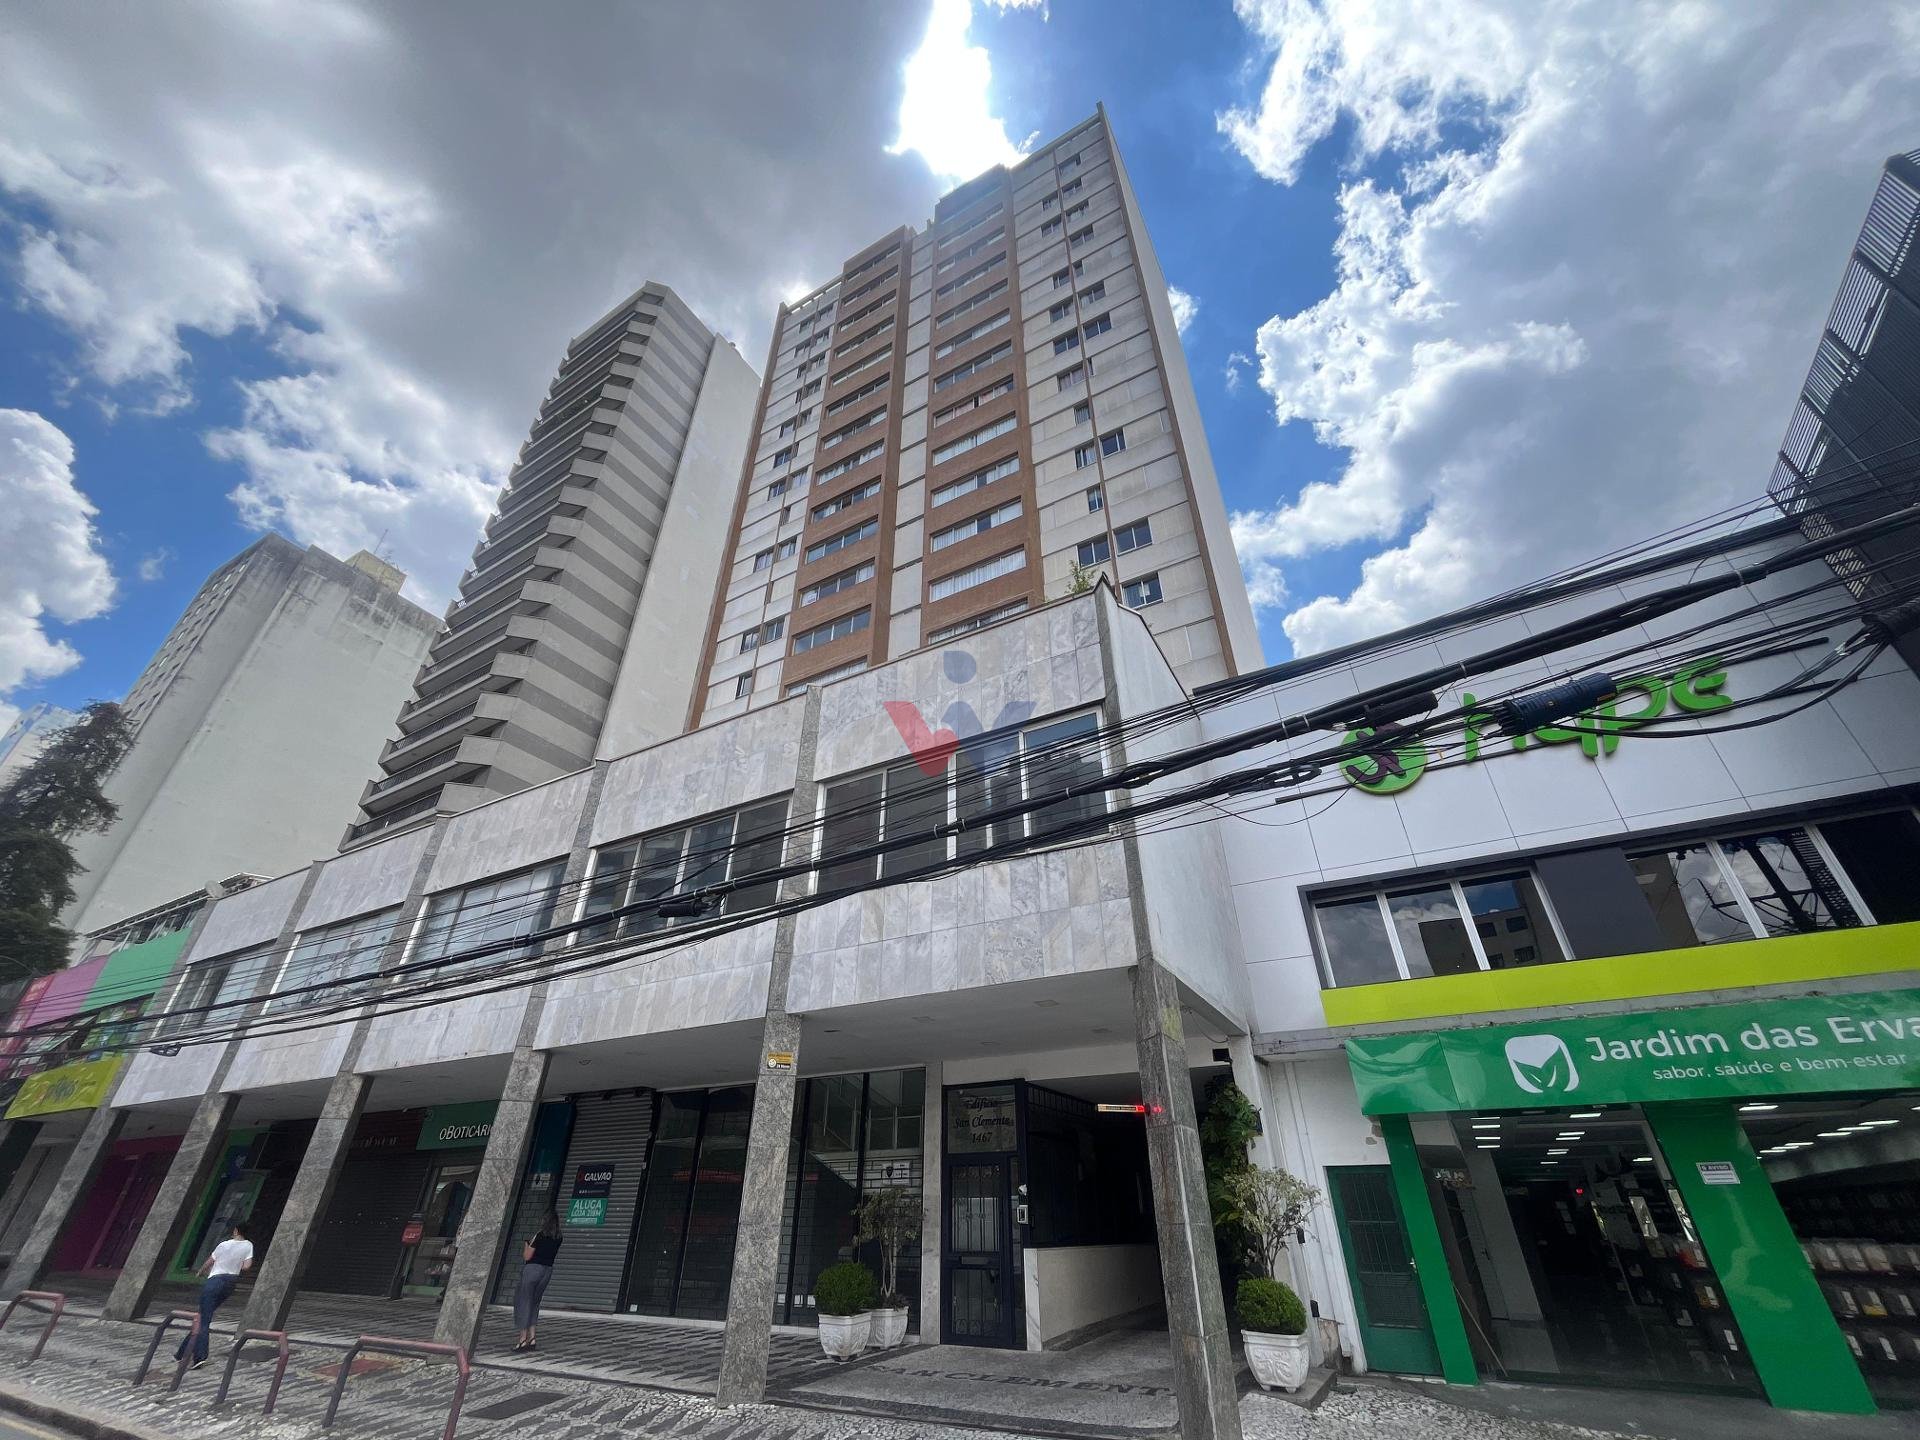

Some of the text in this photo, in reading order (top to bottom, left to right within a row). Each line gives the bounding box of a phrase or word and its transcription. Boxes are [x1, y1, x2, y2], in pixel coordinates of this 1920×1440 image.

[1585, 1028, 1730, 1062] Jardim
[1740, 1022, 1819, 1050] das
[1714, 1060, 1774, 1076] saúde
[1779, 1061, 1792, 1072] e
[1795, 1053, 1907, 1071] bem-estar
[972, 1132, 993, 1144] 1467
[573, 1199, 602, 1210] ALUGA
